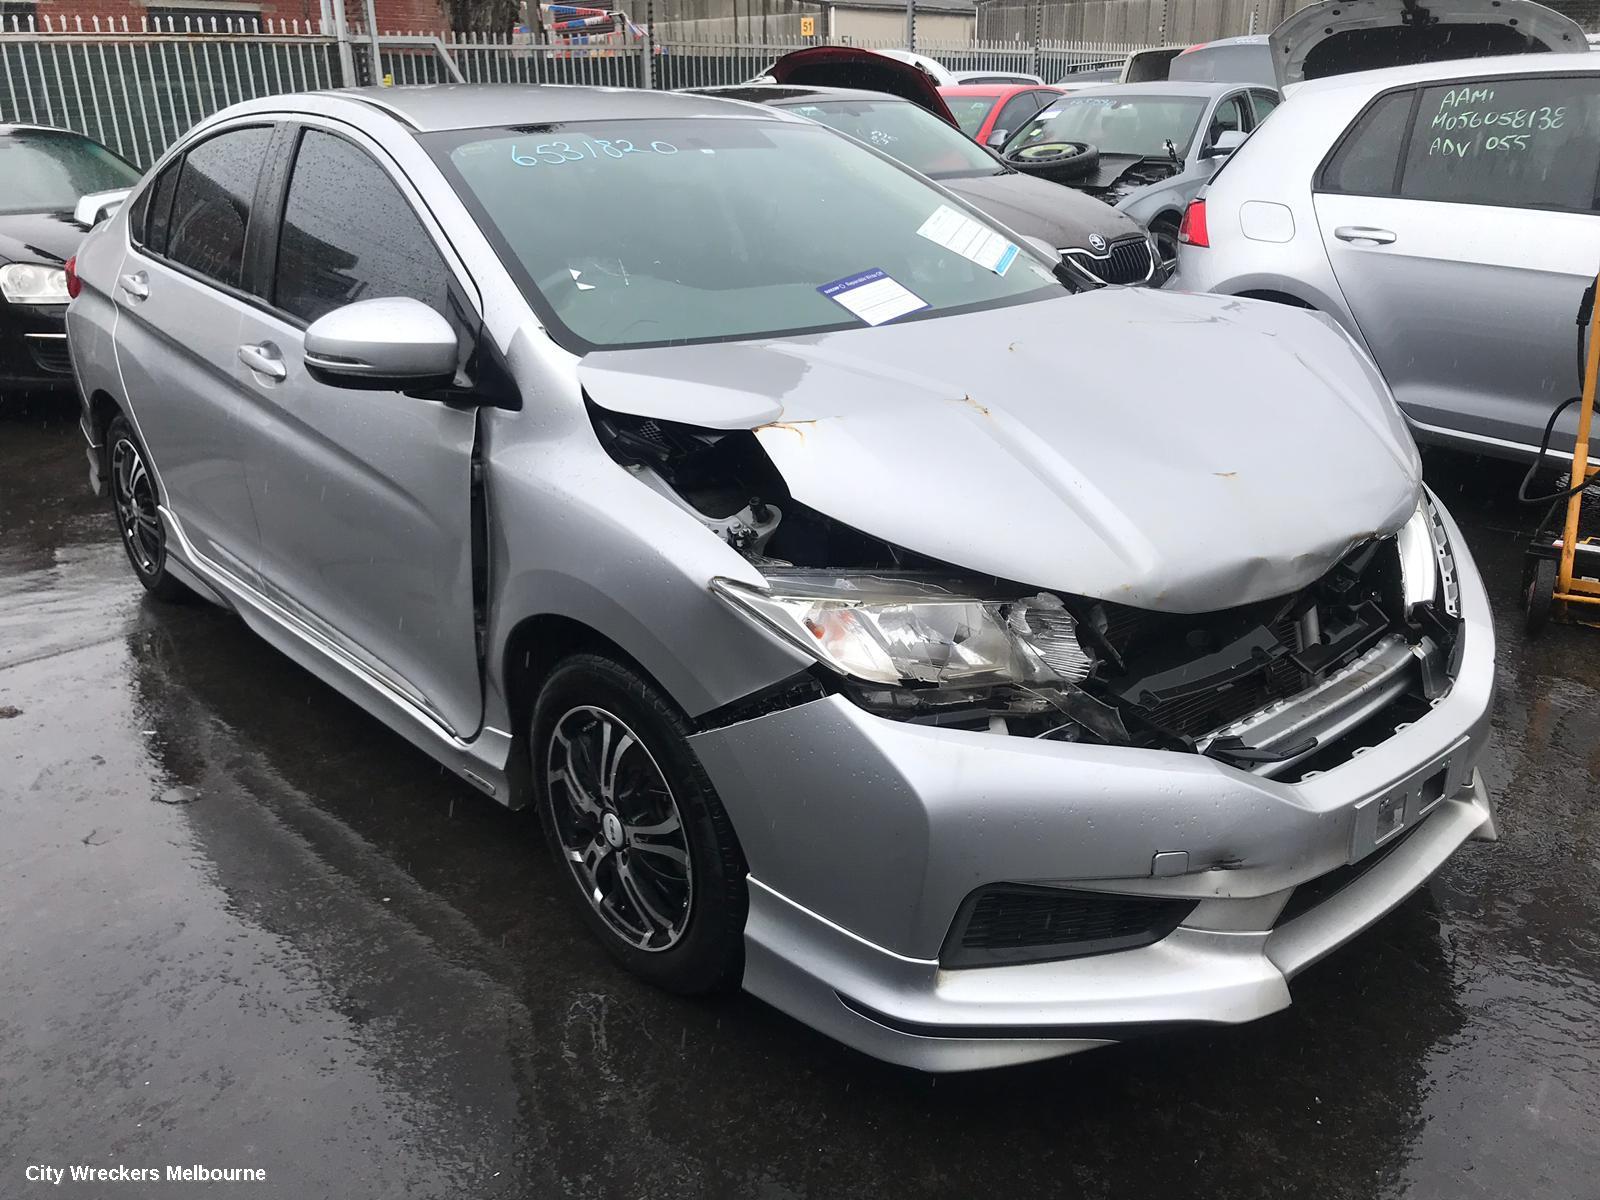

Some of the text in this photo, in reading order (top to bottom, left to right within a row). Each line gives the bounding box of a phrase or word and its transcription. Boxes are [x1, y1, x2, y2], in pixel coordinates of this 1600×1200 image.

[803, 21, 813, 33] 51
[1439, 88, 1495, 112] AAMI
[1429, 134, 1531, 158] ADV 055
